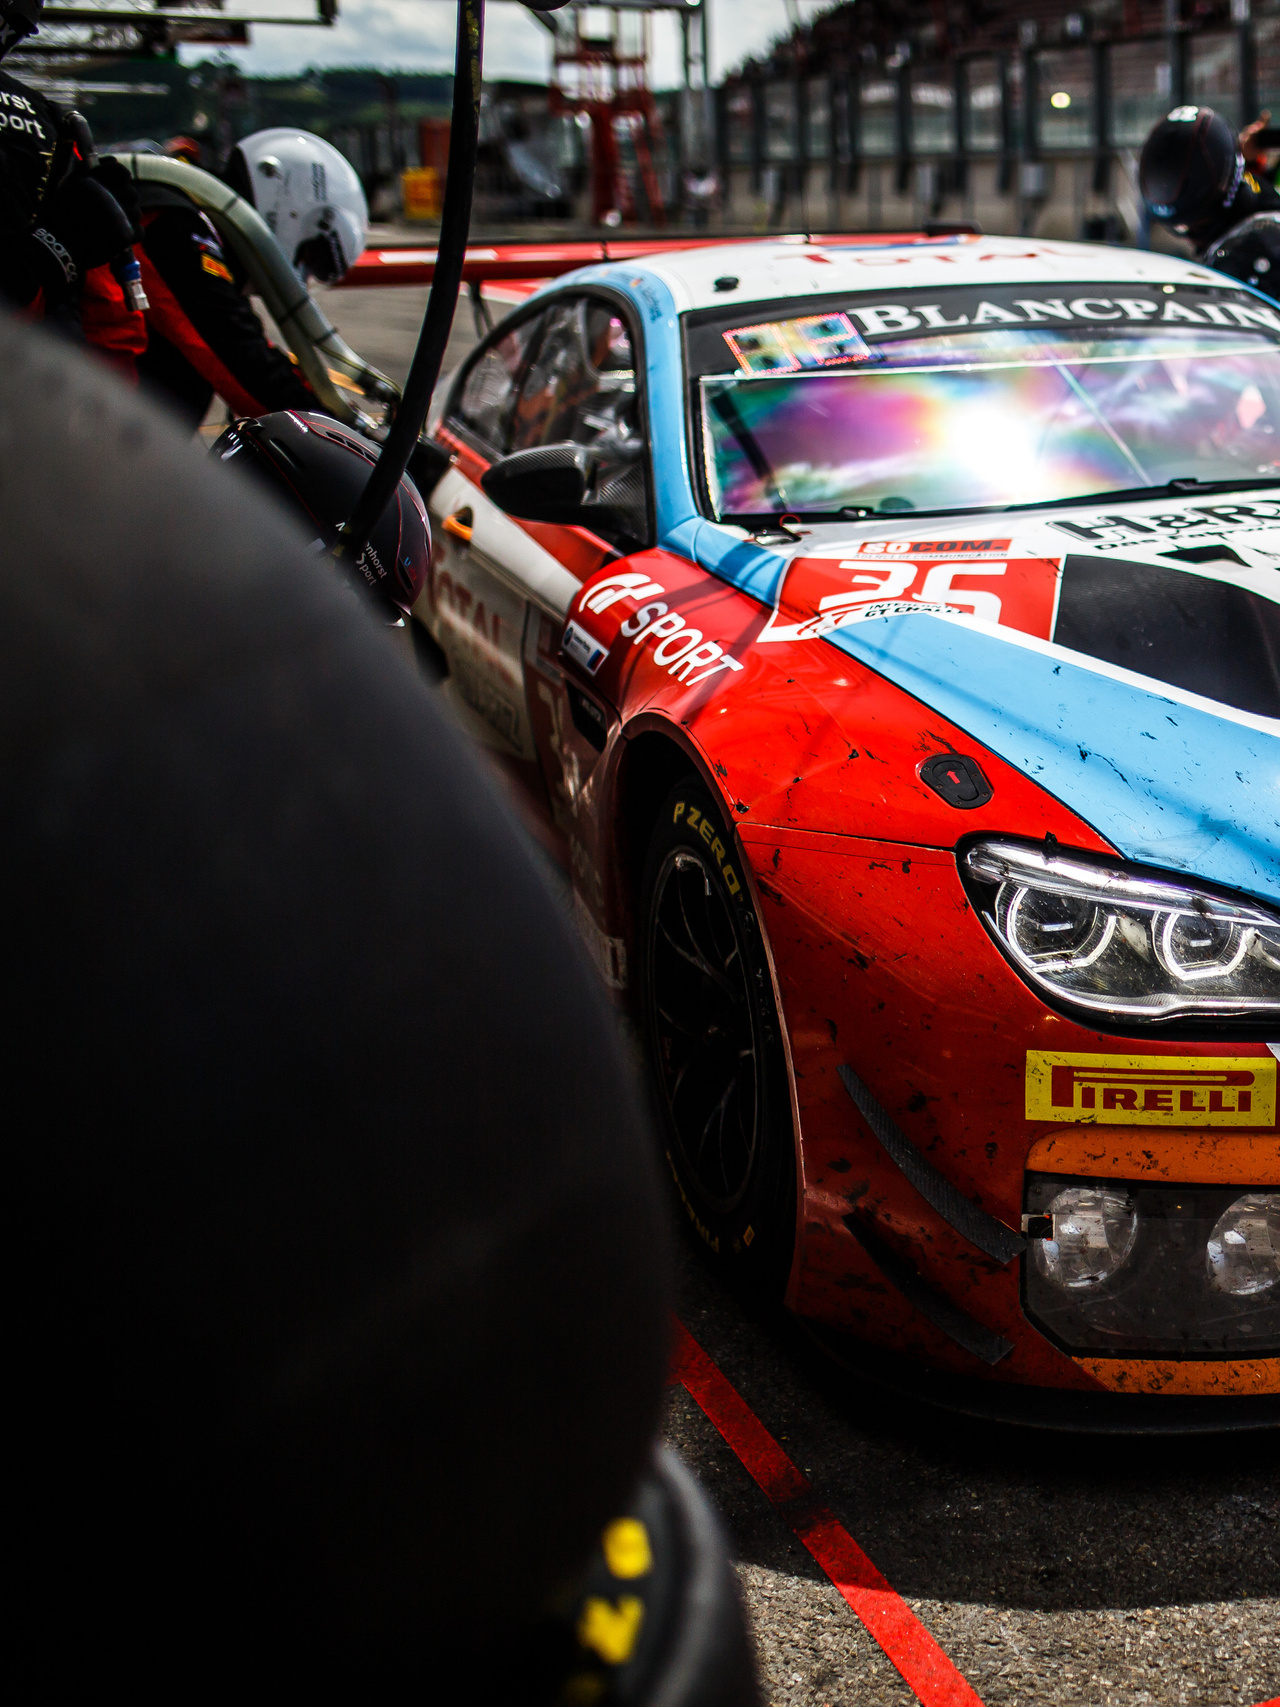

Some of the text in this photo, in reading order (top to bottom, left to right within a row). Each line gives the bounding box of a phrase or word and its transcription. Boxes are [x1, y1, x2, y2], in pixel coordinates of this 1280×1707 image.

[620, 601, 745, 687] SPORT
[864, 608, 892, 618] GT
[686, 806, 742, 895] ZERO
[1051, 1065, 1255, 1113] PIRELLI
